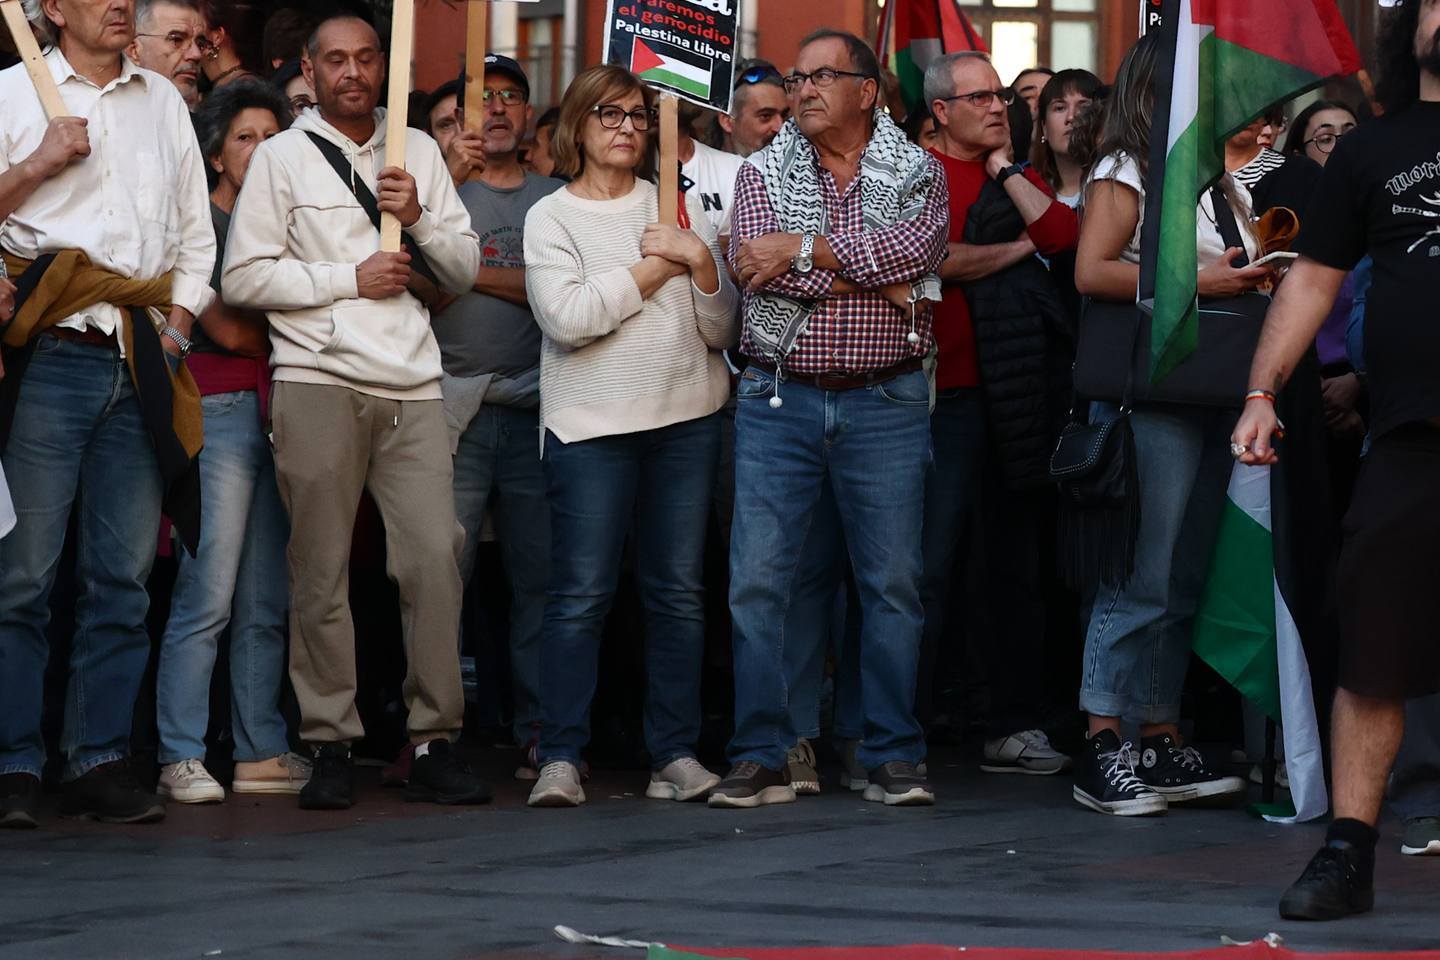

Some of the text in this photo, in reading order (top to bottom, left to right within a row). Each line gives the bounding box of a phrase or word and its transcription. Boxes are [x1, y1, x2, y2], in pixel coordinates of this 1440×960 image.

[616, 19, 730, 62] Palestina libre
[618, 5, 731, 45] el genocidio
